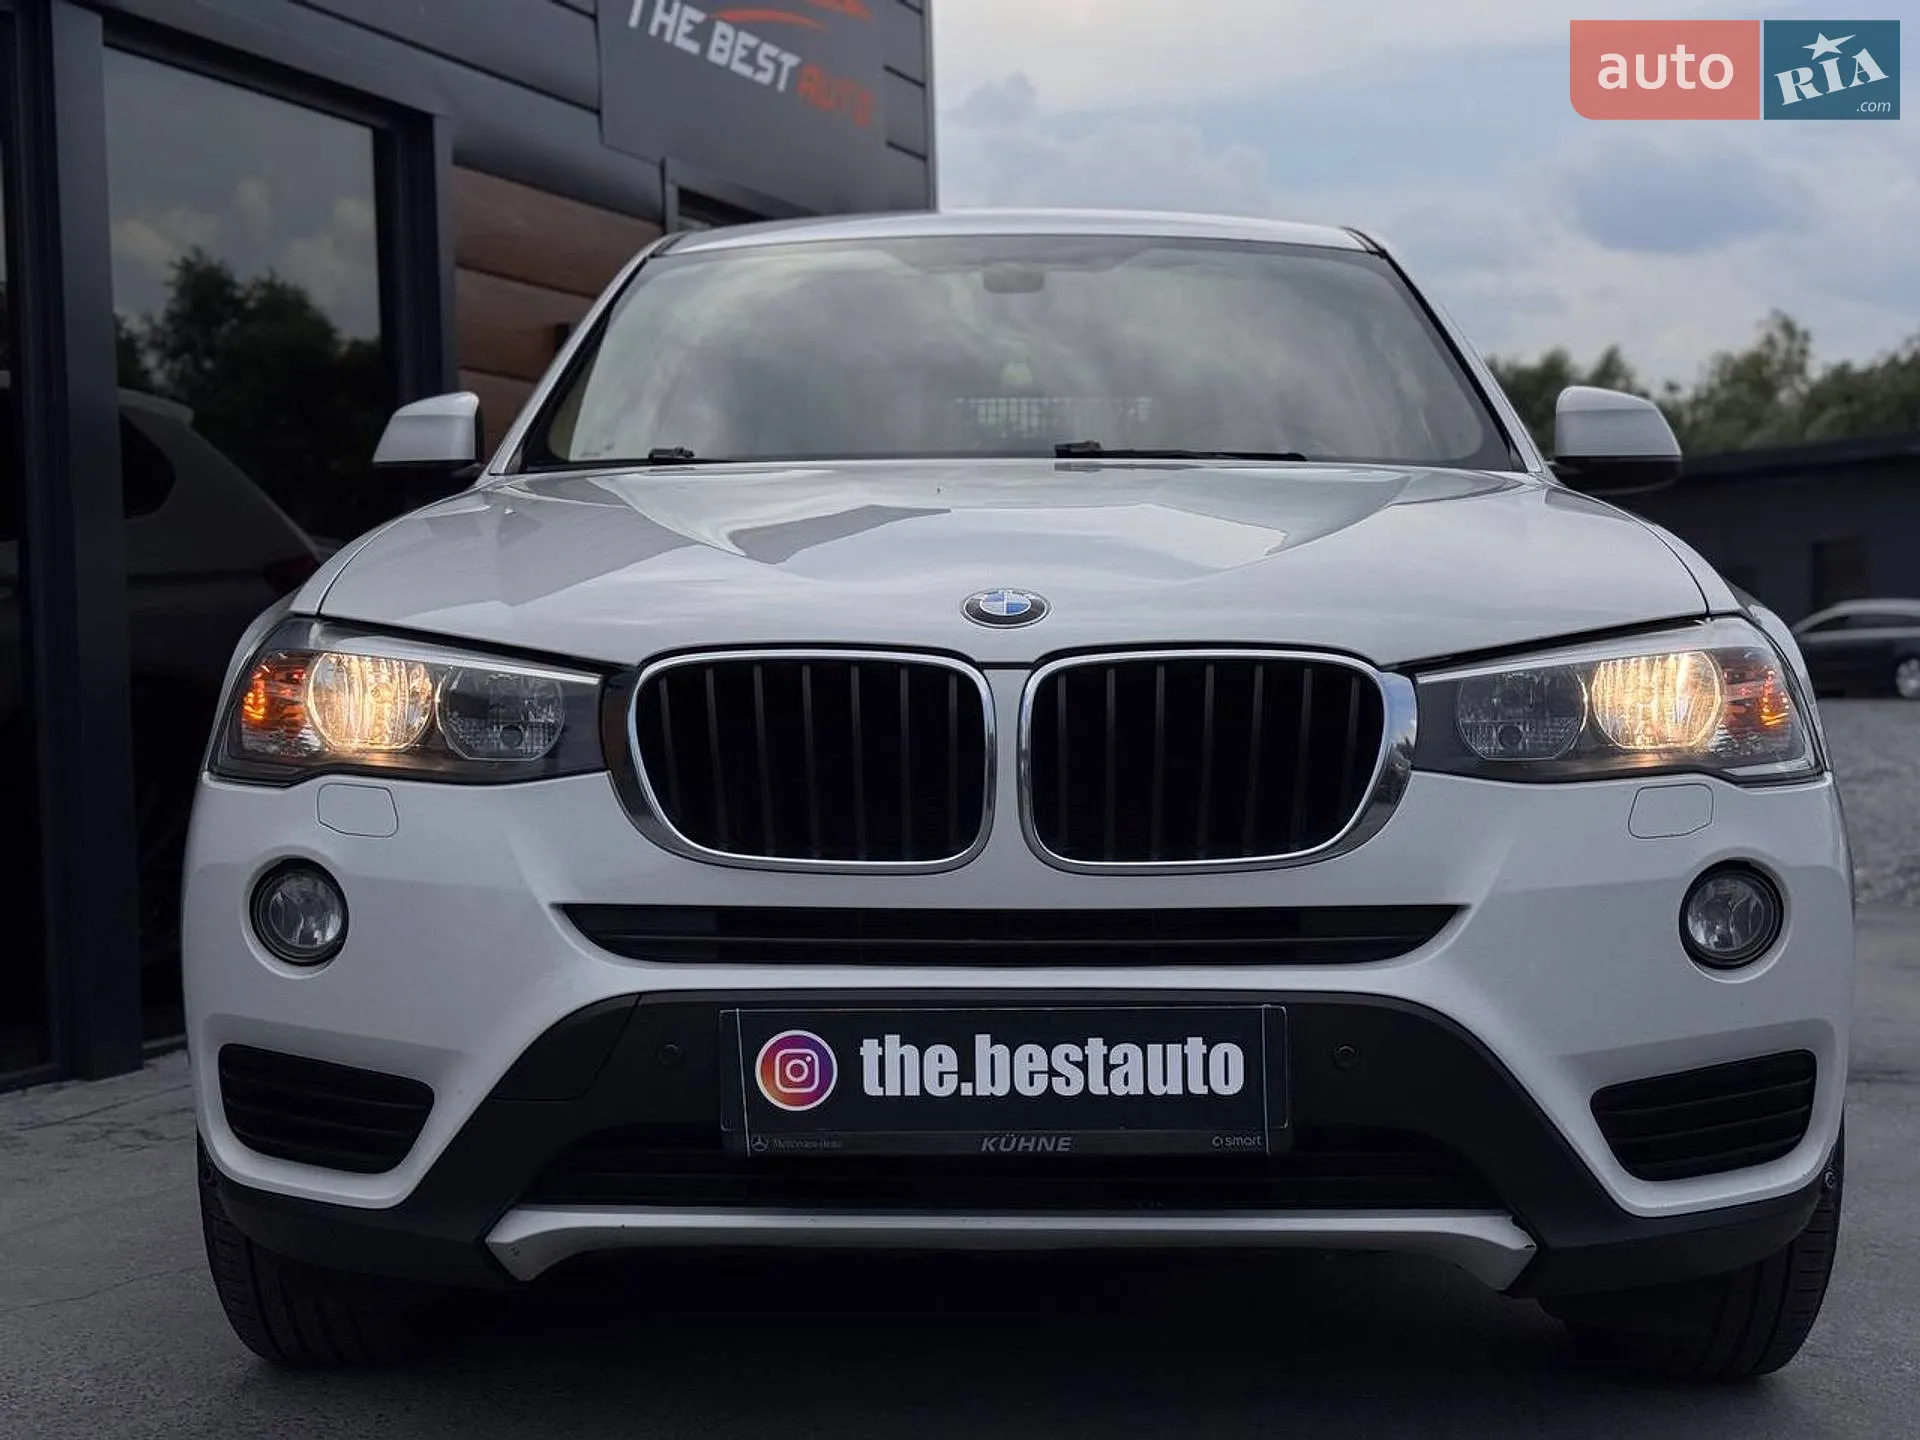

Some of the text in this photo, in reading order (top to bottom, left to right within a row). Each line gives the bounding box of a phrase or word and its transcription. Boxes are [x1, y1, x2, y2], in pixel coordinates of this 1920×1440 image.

[706, 20, 802, 92] BEST
[860, 1034, 1244, 1097] the.bestauto
[981, 1134, 1073, 1152] KÜHNE
[1224, 1135, 1262, 1147] smart
